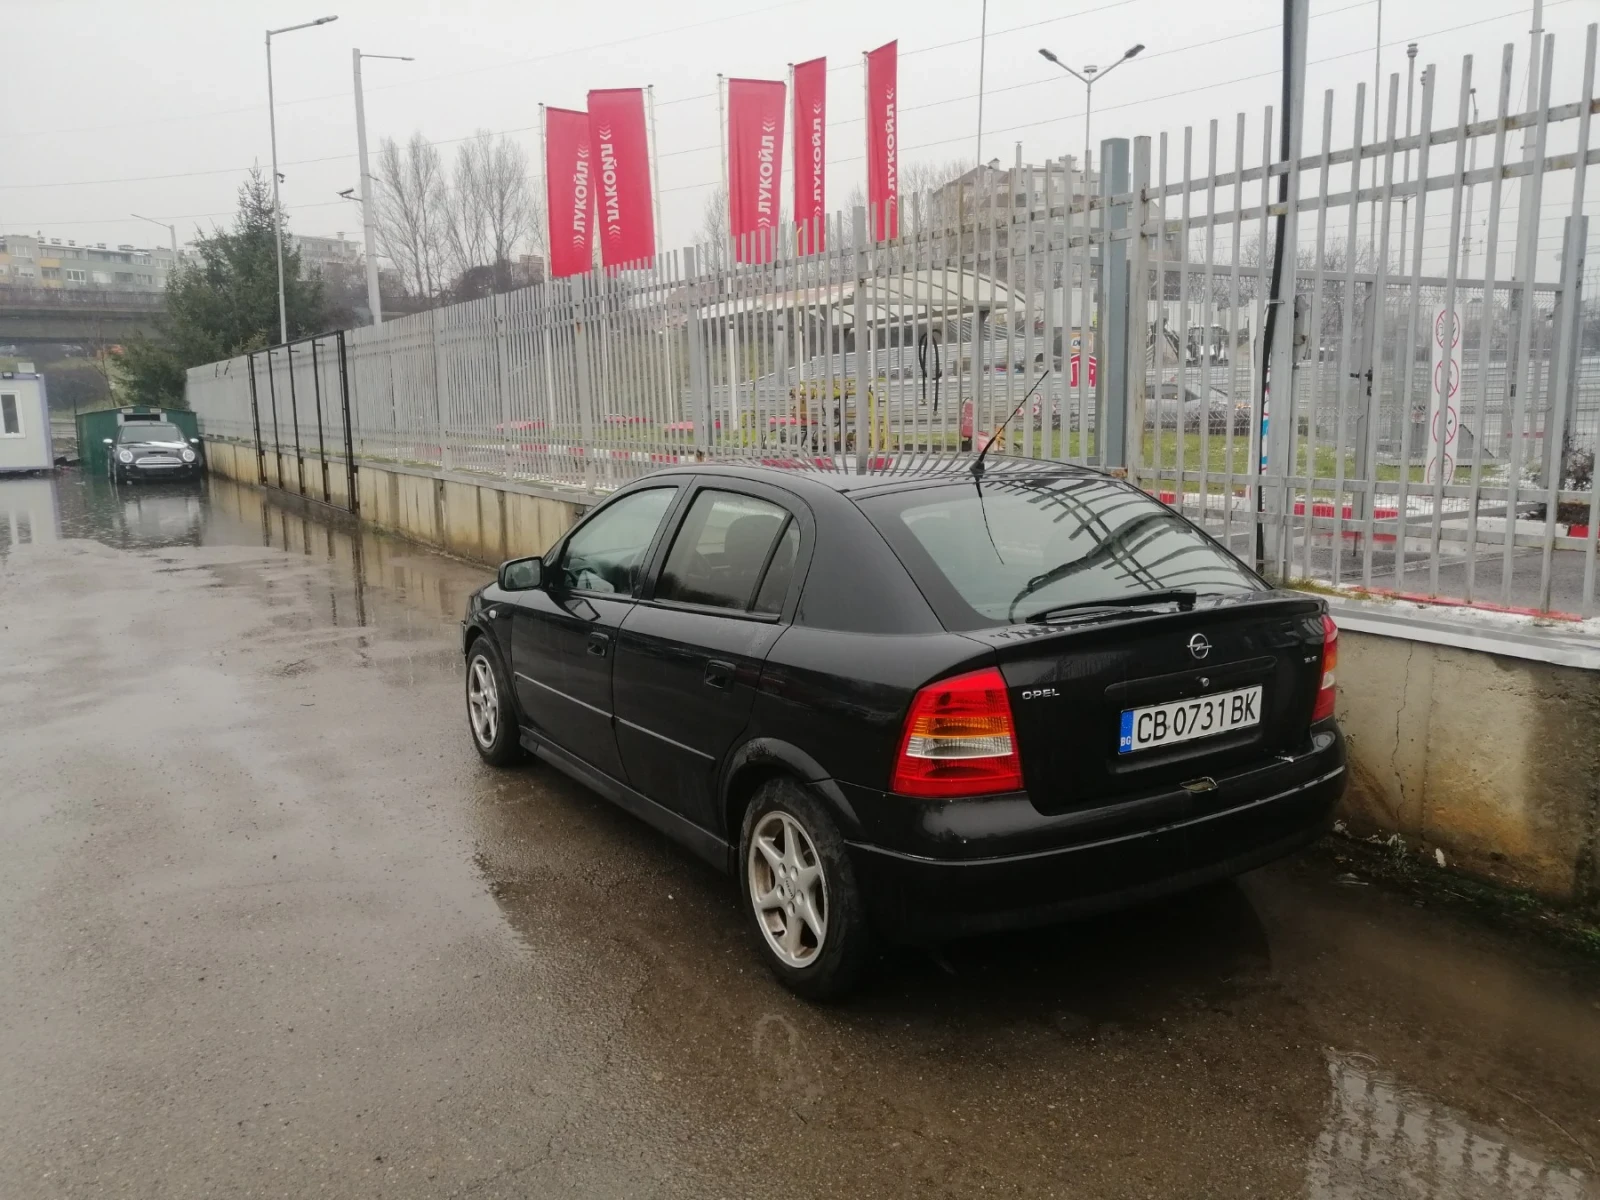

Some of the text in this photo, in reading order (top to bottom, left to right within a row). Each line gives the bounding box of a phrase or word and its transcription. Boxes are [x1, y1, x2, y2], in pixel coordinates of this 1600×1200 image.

[758, 135, 775, 215] ЛУКОЙЛ
[812, 118, 822, 203] ЛУКОЙЛ
[885, 103, 896, 191] ЛУКОЙЛ
[573, 161, 589, 233] ЛУКОЙЛ
[1021, 688, 1060, 700] OPEL
[1137, 691, 1257, 743] CB 0731 BK
[1120, 735, 1132, 747] BG
